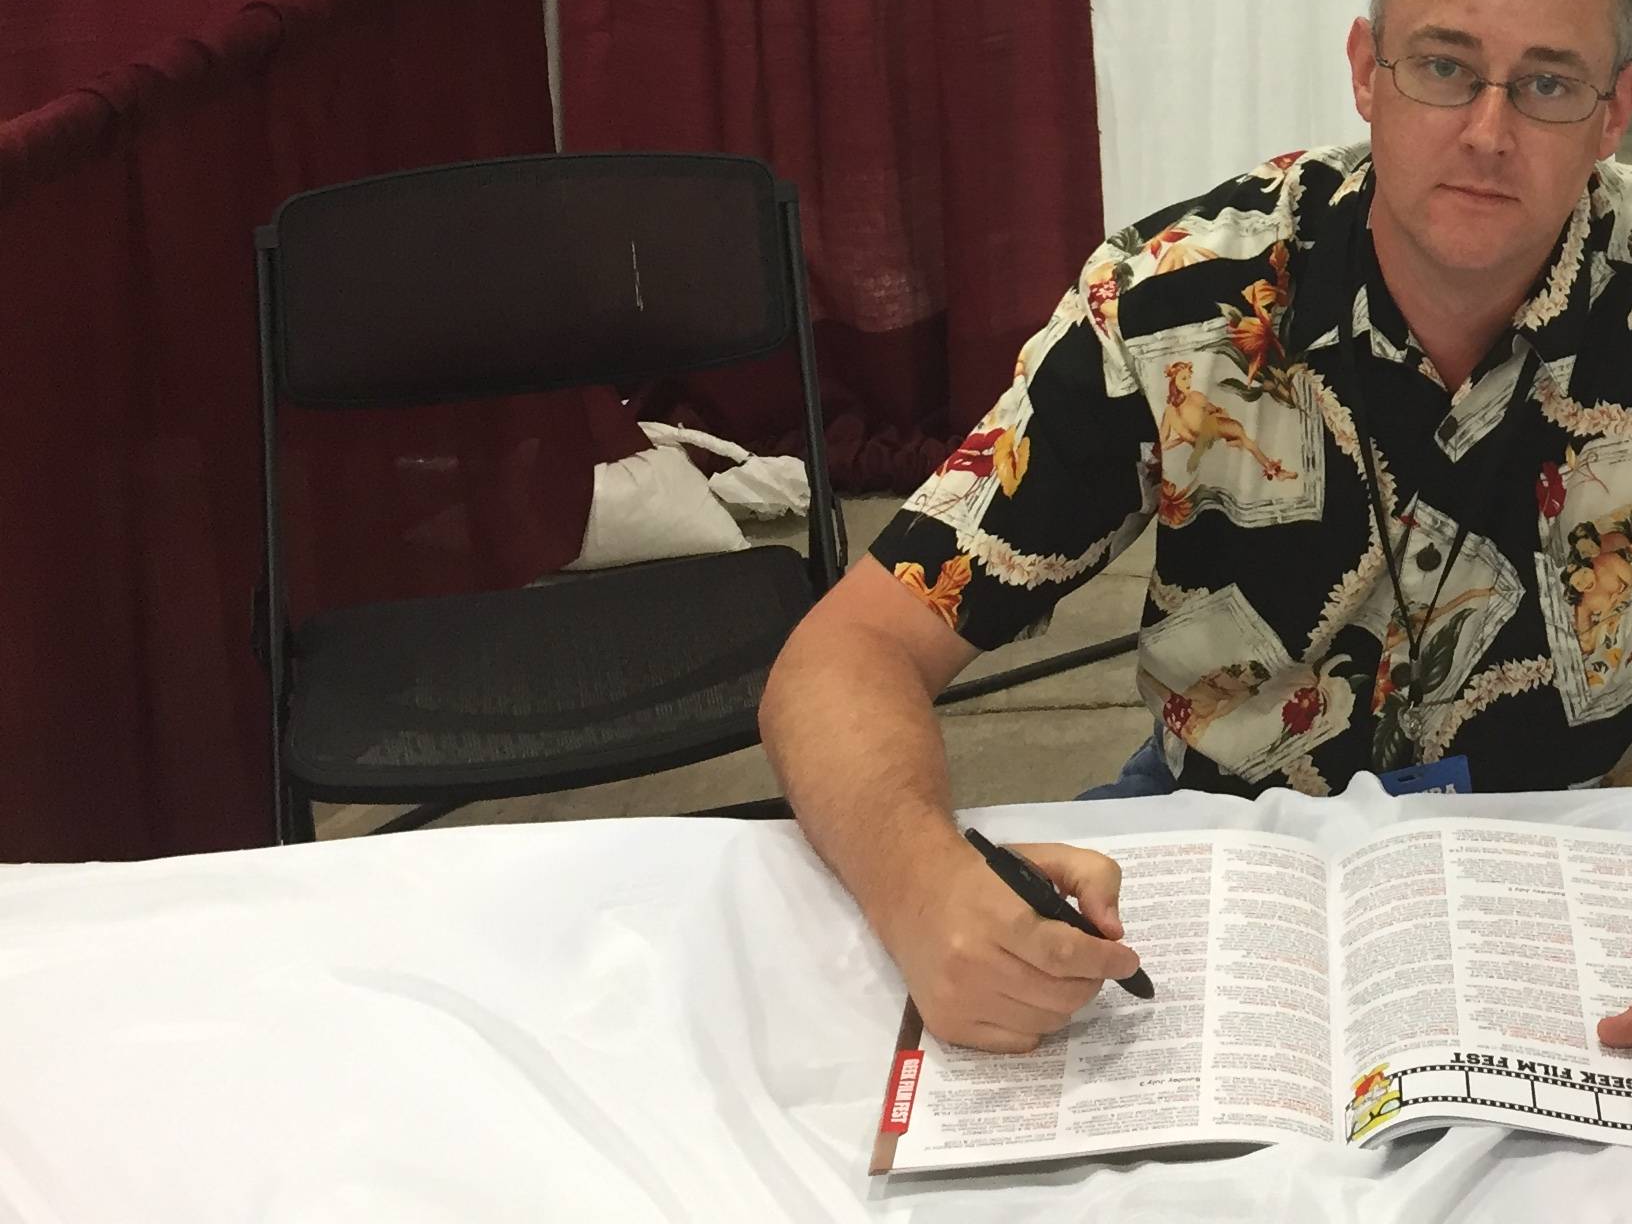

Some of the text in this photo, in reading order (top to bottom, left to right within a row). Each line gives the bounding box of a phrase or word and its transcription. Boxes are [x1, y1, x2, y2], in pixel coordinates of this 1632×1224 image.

[1450, 1051, 1509, 1069] FEST
[1516, 1058, 1576, 1079] FILM
[890, 1058, 920, 1124] GEEK FILM FEST
